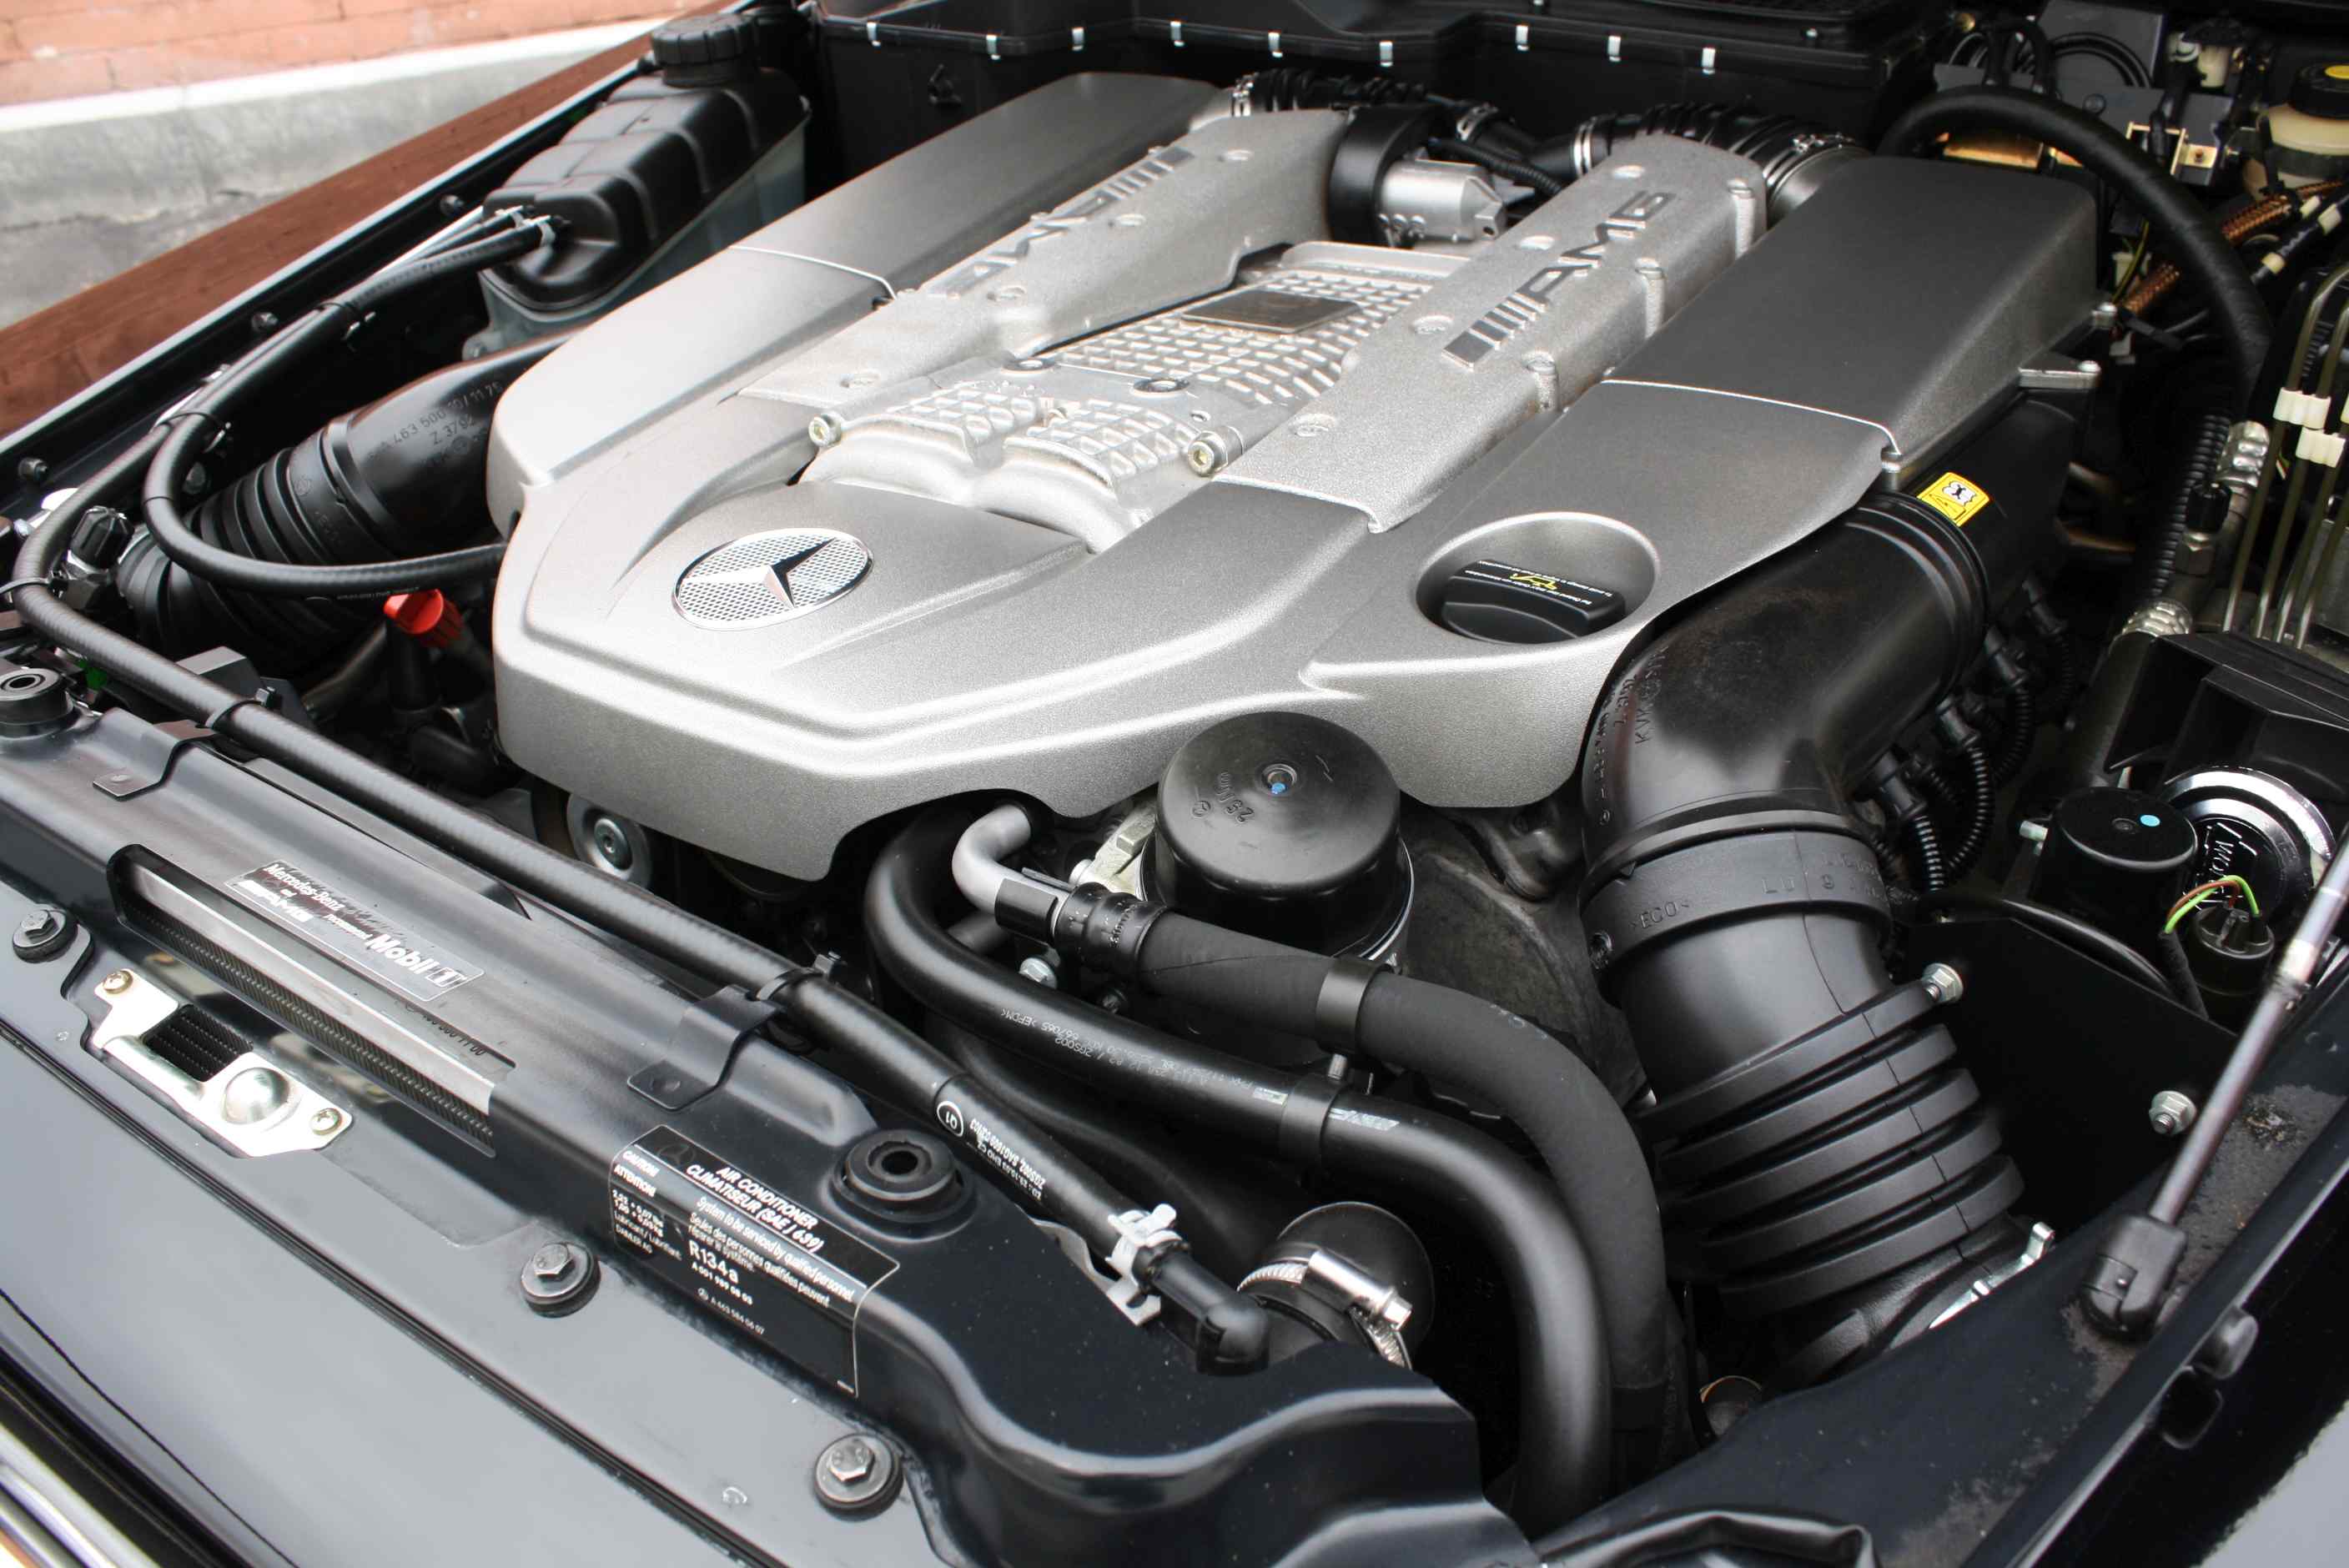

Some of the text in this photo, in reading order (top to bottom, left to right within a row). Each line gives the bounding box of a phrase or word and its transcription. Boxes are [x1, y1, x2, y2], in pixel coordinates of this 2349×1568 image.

[1508, 191, 1675, 312] AMG
[263, 863, 345, 912] Mercedes-Benz
[365, 934, 440, 974] Mobil
[687, 1163, 825, 1254] CLIMATISEUR (SAE J 639)
[716, 1167, 818, 1230] AIR CONDITIONER
[688, 1239, 739, 1284] R134a
